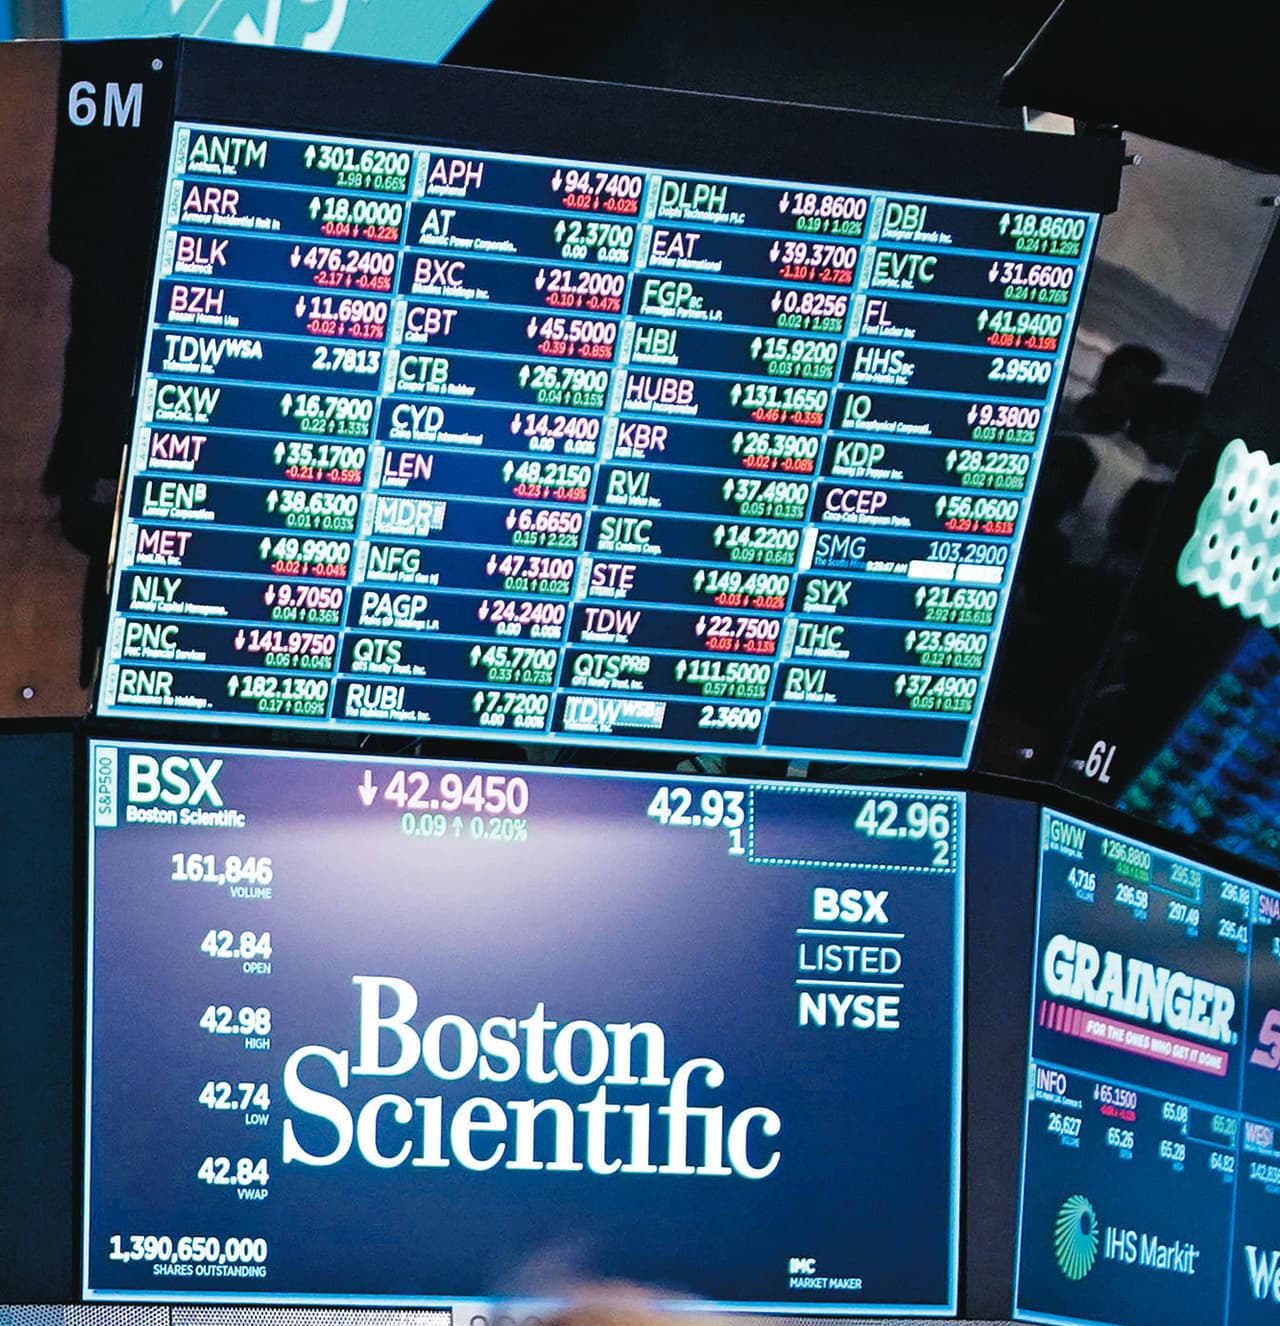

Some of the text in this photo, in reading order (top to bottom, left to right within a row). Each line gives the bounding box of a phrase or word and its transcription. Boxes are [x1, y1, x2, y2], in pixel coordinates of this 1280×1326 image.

[67, 81, 143, 128] 6M
[190, 134, 410, 175] ANTM 301.6200
[662, 180, 868, 220] DLPH 18.8600
[177, 235, 395, 275] BLK 476.2400
[874, 252, 1074, 290] EVTC 31.6600
[626, 378, 828, 412] HUBB 131.1650
[151, 433, 366, 468] KMT 35.1700
[825, 488, 1019, 522] CCEP 56.0600
[591, 563, 791, 599] STE 149.4900
[363, 593, 566, 626] PAGP 24.2400
[120, 671, 329, 701] RNR 182.1300
[1085, 740, 1117, 783] 6L
[99, 757, 112, 814] S&P500
[129, 754, 950, 840] BSX 42.9450 42.93 42.96
[126, 806, 528, 843] Boston Scientific 0.09 0.20%
[172, 854, 273, 888] 161,846
[230, 886, 272, 899] VOLUME
[814, 888, 889, 924] BSX
[201, 931, 272, 960] 42.84
[799, 944, 902, 975] LISTED
[243, 962, 272, 974] OPEN
[1043, 934, 1235, 1045] GRAINGER
[200, 1006, 272, 1035] 42.98
[799, 993, 900, 1029] NYSE
[245, 1037, 270, 1050] HIGH
[351, 975, 672, 1087] Boston
[198, 1083, 270, 1110] 42.74
[1037, 1068, 1137, 1110] INFO 65.1500
[245, 1113, 270, 1125] LOW
[282, 1044, 783, 1179] Scientific
[1048, 1112, 1082, 1137] 26,627
[1107, 1127, 1134, 1149] 65.26
[1159, 1140, 1186, 1162] 65.28
[198, 1158, 269, 1187] 42.84
[237, 1188, 268, 1200] VWAP
[109, 1235, 267, 1265] 1,390,650,000
[790, 1258, 816, 1275] IMC
[1104, 1225, 1196, 1275] IHS Markit
[153, 1263, 267, 1278] SHARES OUTSTANDING
[790, 1276, 863, 1290] MARKET MAKER
